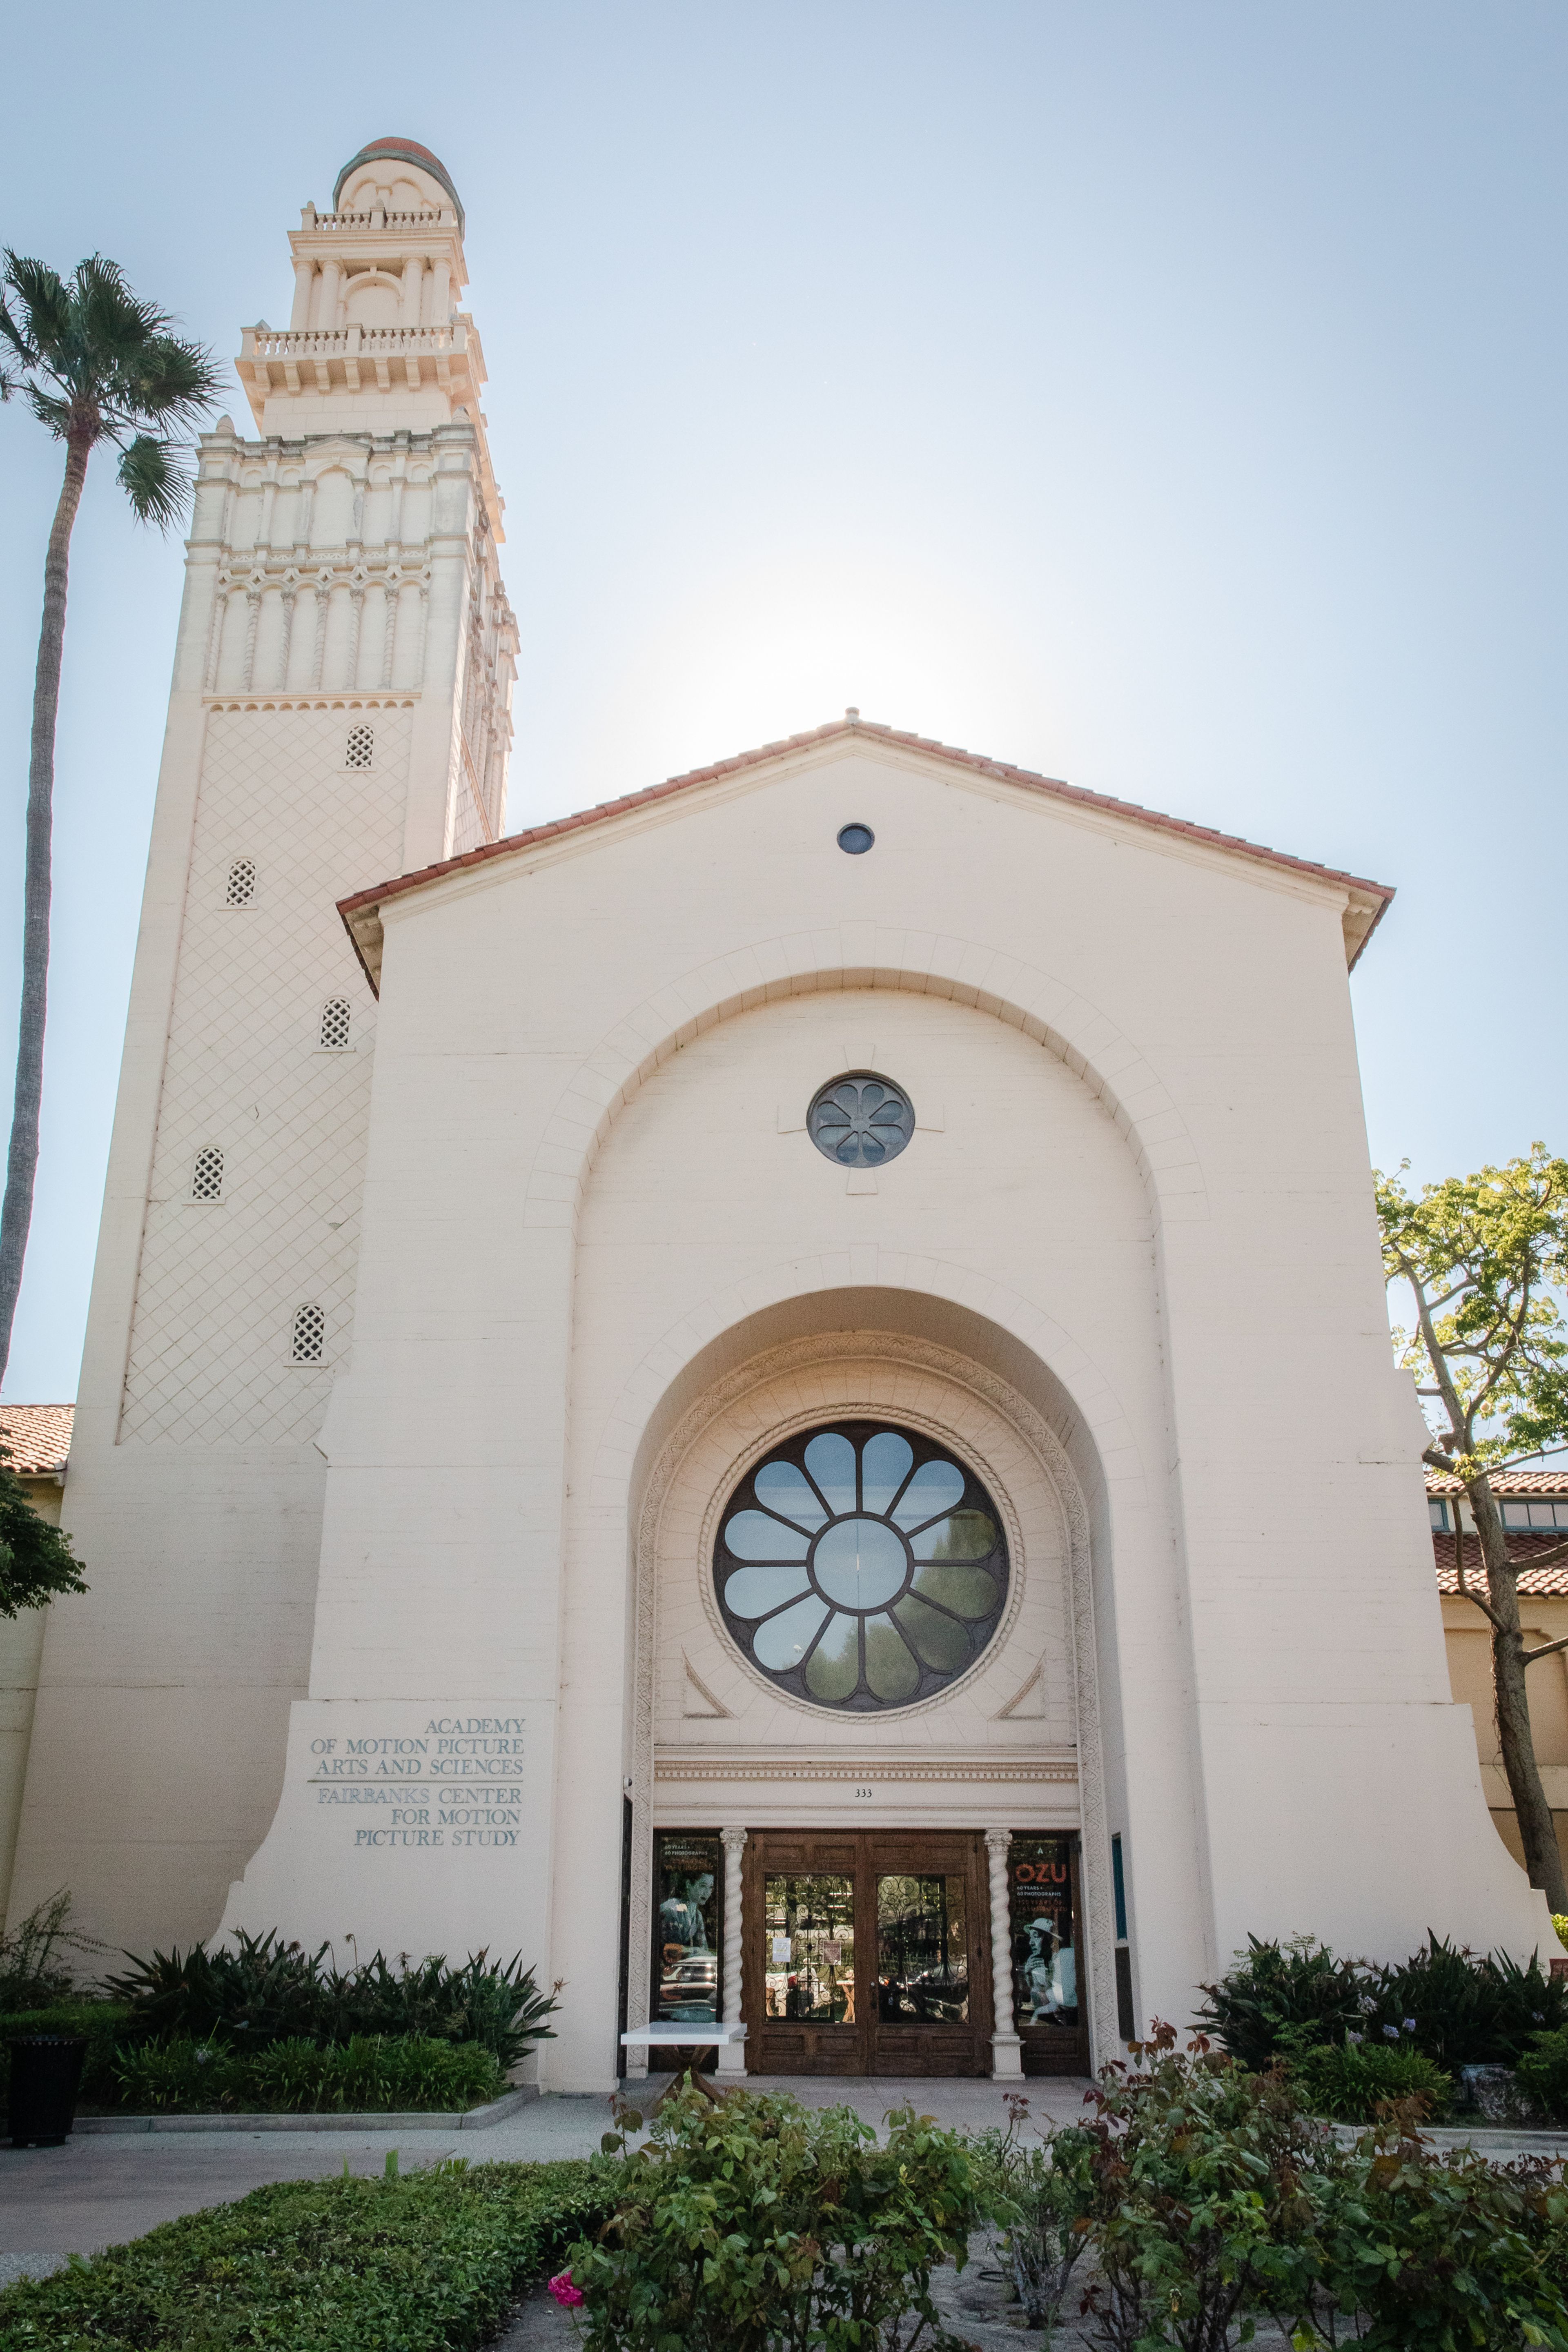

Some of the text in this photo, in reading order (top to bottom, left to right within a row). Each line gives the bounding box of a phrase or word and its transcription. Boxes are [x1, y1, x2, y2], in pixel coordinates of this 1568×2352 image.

[425, 1718, 526, 1734] ACADEMY
[310, 1739, 524, 1755] OF MOTION PICTURE
[316, 1759, 523, 1775] ARTS AND SCIENCES
[318, 1788, 522, 1804] FAIRBANKS CENTER
[855, 1788, 872, 1798] 333
[391, 1809, 521, 1825] FOR MOTION
[354, 1829, 521, 1846] PICTURE STUDY
[1015, 1863, 1067, 1883] OZU
